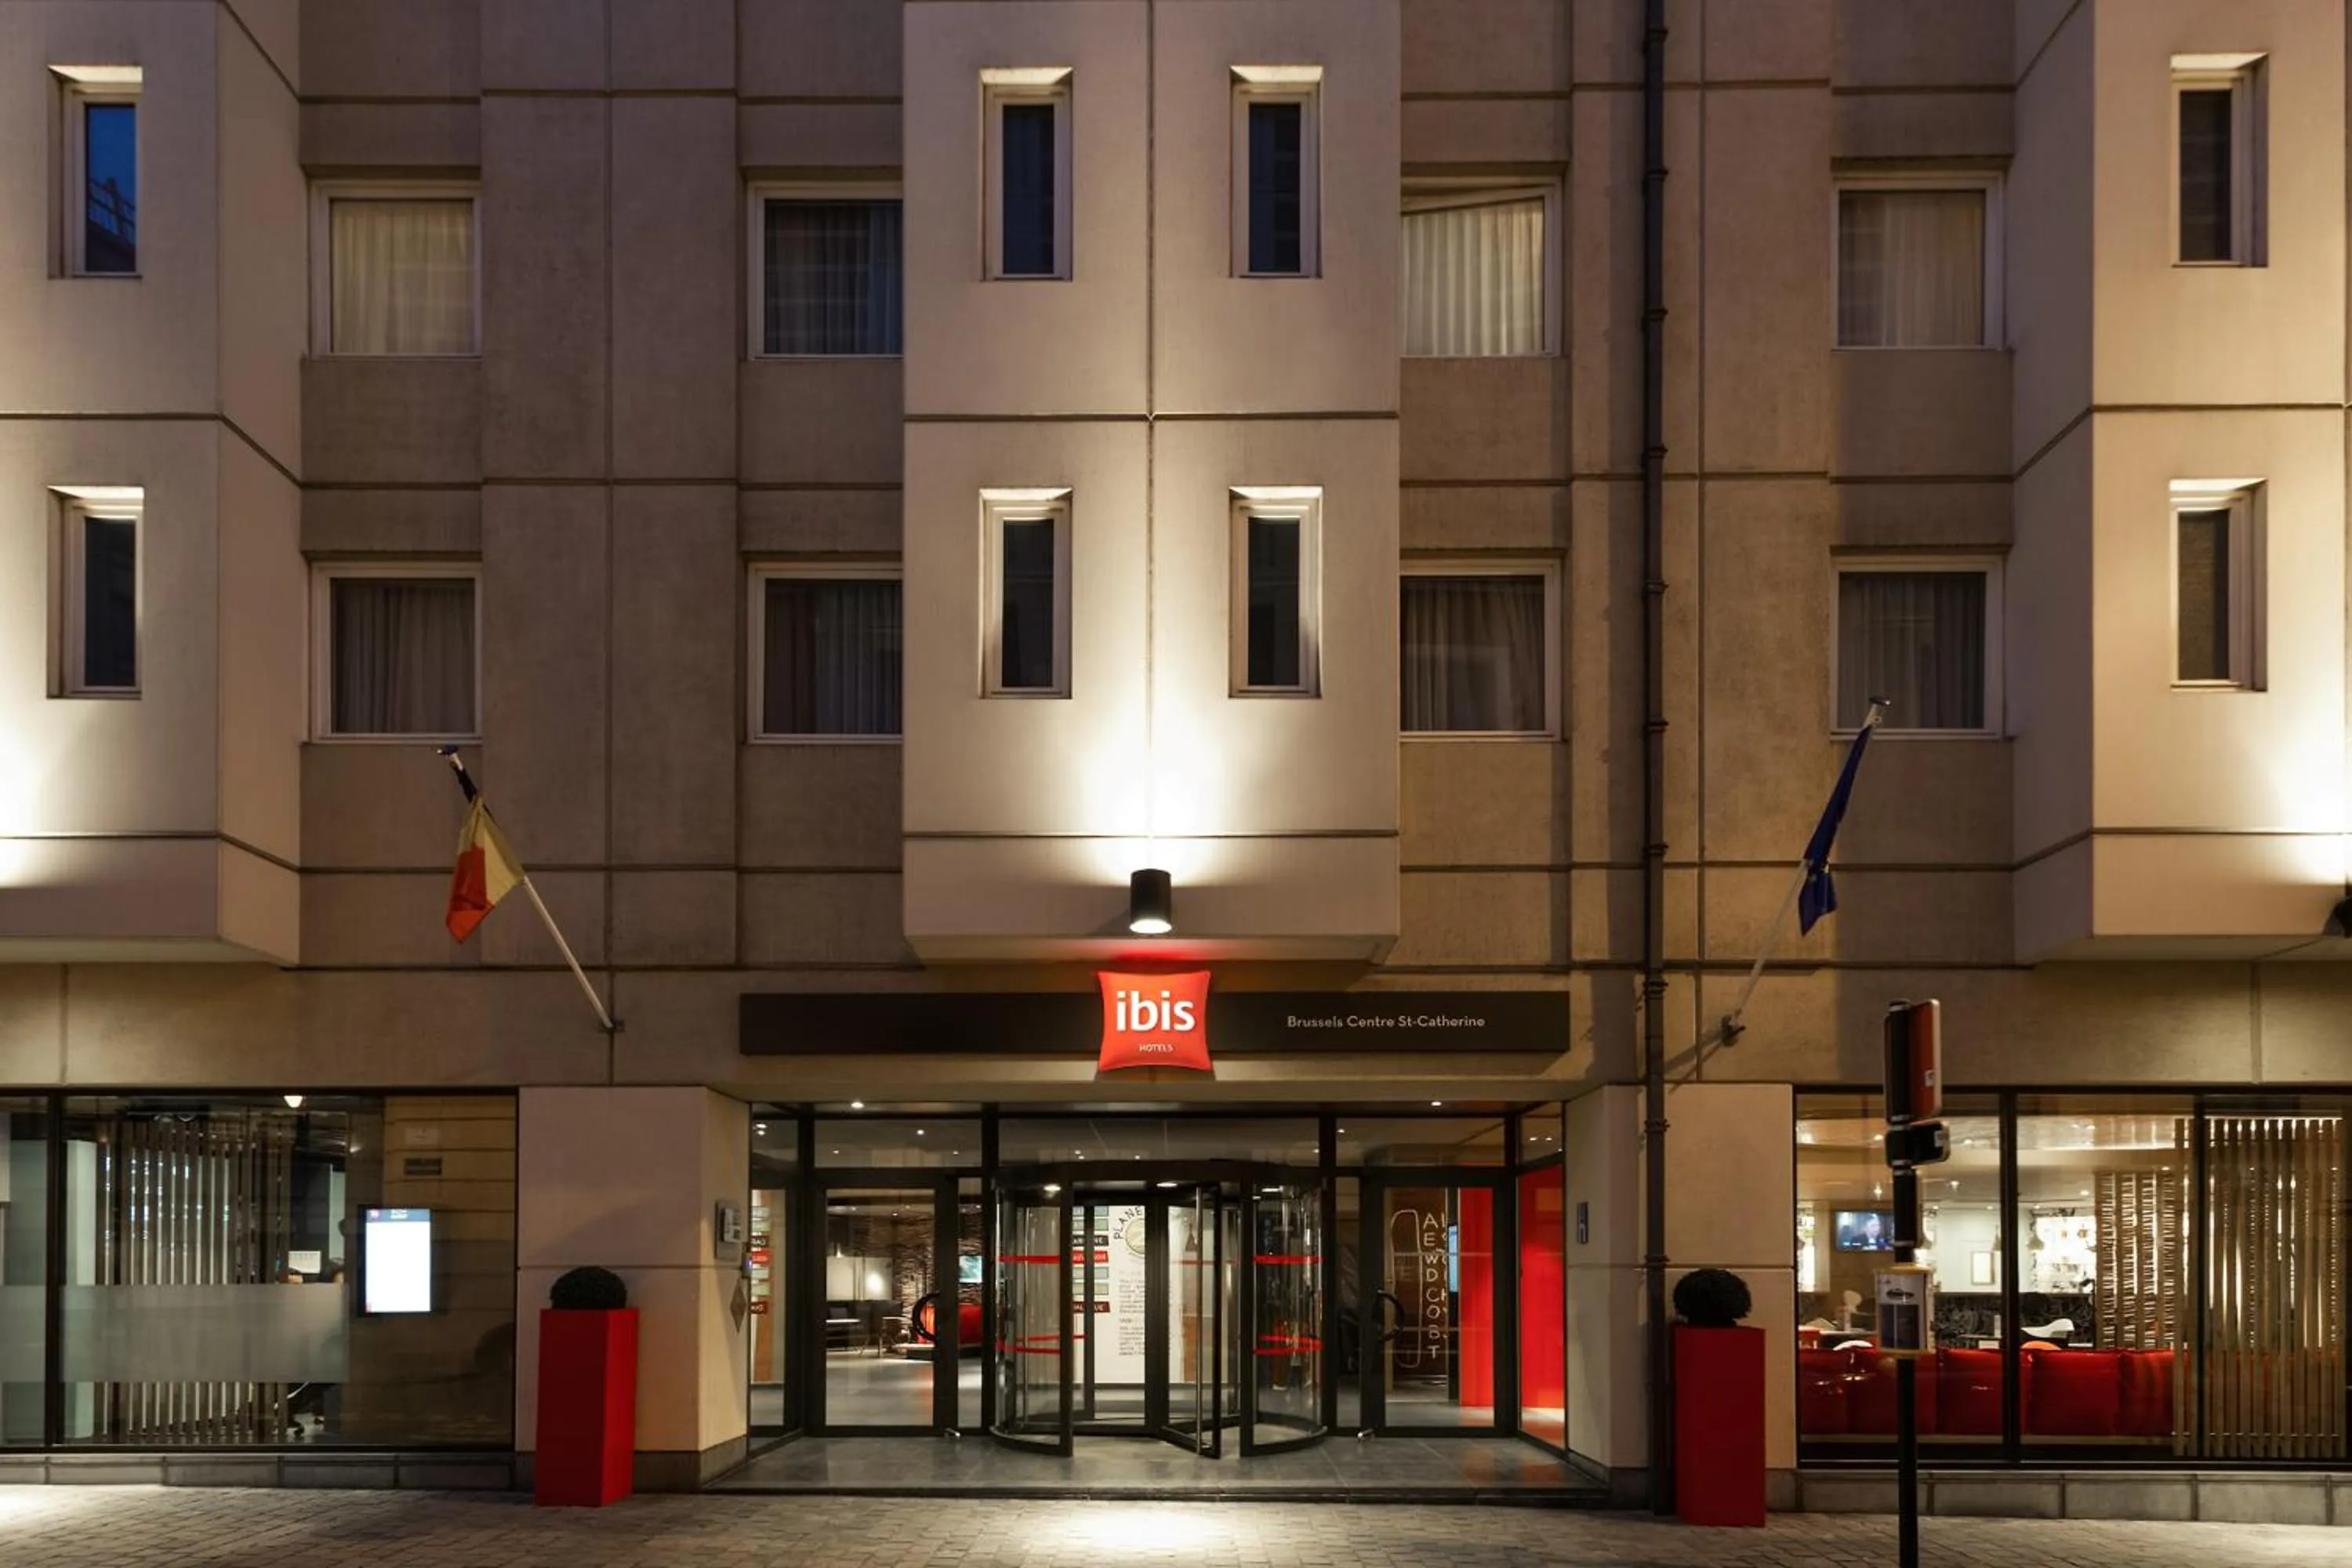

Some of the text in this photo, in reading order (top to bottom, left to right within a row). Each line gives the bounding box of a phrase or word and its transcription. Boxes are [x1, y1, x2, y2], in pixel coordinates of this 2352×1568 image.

[1116, 990, 1196, 1032] ibis
[1287, 1014, 1486, 1028] Brussels Centre St-Catherine
[1139, 1044, 1174, 1052] HOTELS
